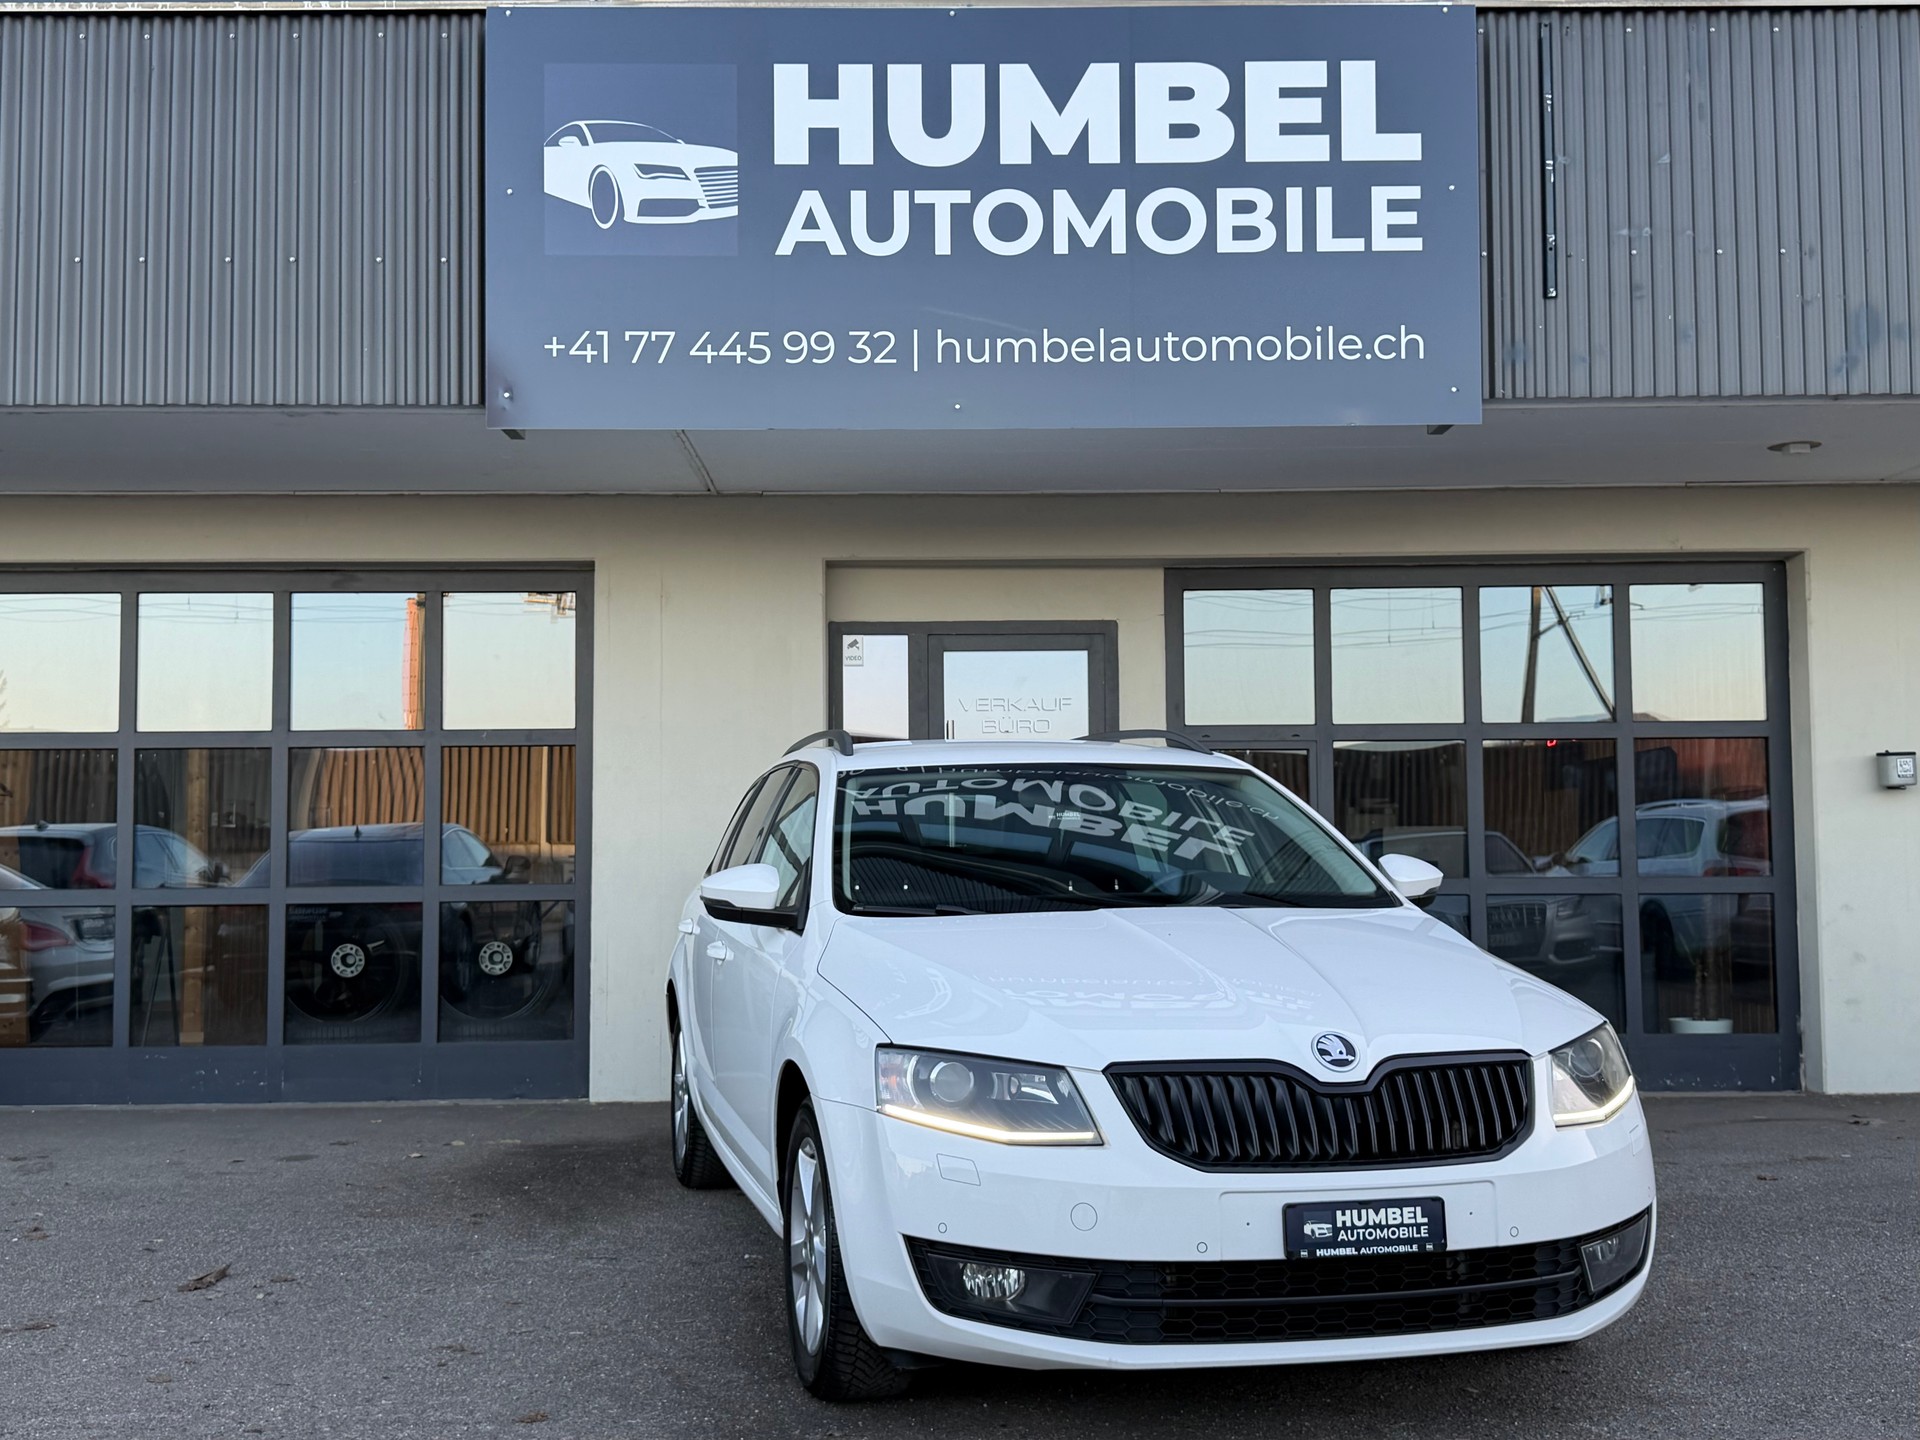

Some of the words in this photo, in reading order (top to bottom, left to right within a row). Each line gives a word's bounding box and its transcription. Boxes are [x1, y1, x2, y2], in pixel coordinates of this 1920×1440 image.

[773, 60, 1422, 167] HUMBEL
[774, 185, 1423, 257] AUTOMOBILE
[544, 330, 609, 364] +41
[625, 330, 676, 364] 77
[689, 331, 771, 365] 445
[783, 330, 835, 364] 99
[848, 330, 897, 364] 32
[937, 324, 1425, 364] humbelautomobile.ch
[958, 697, 1072, 713] VERKAUF
[981, 716, 1050, 734] BÜRO
[1335, 1206, 1429, 1228] HUMBEL
[1337, 1225, 1429, 1242] AUTOMOBILE
[1316, 1247, 1358, 1257] HUMBEL
[1360, 1244, 1419, 1255] AUTOMOBILE
